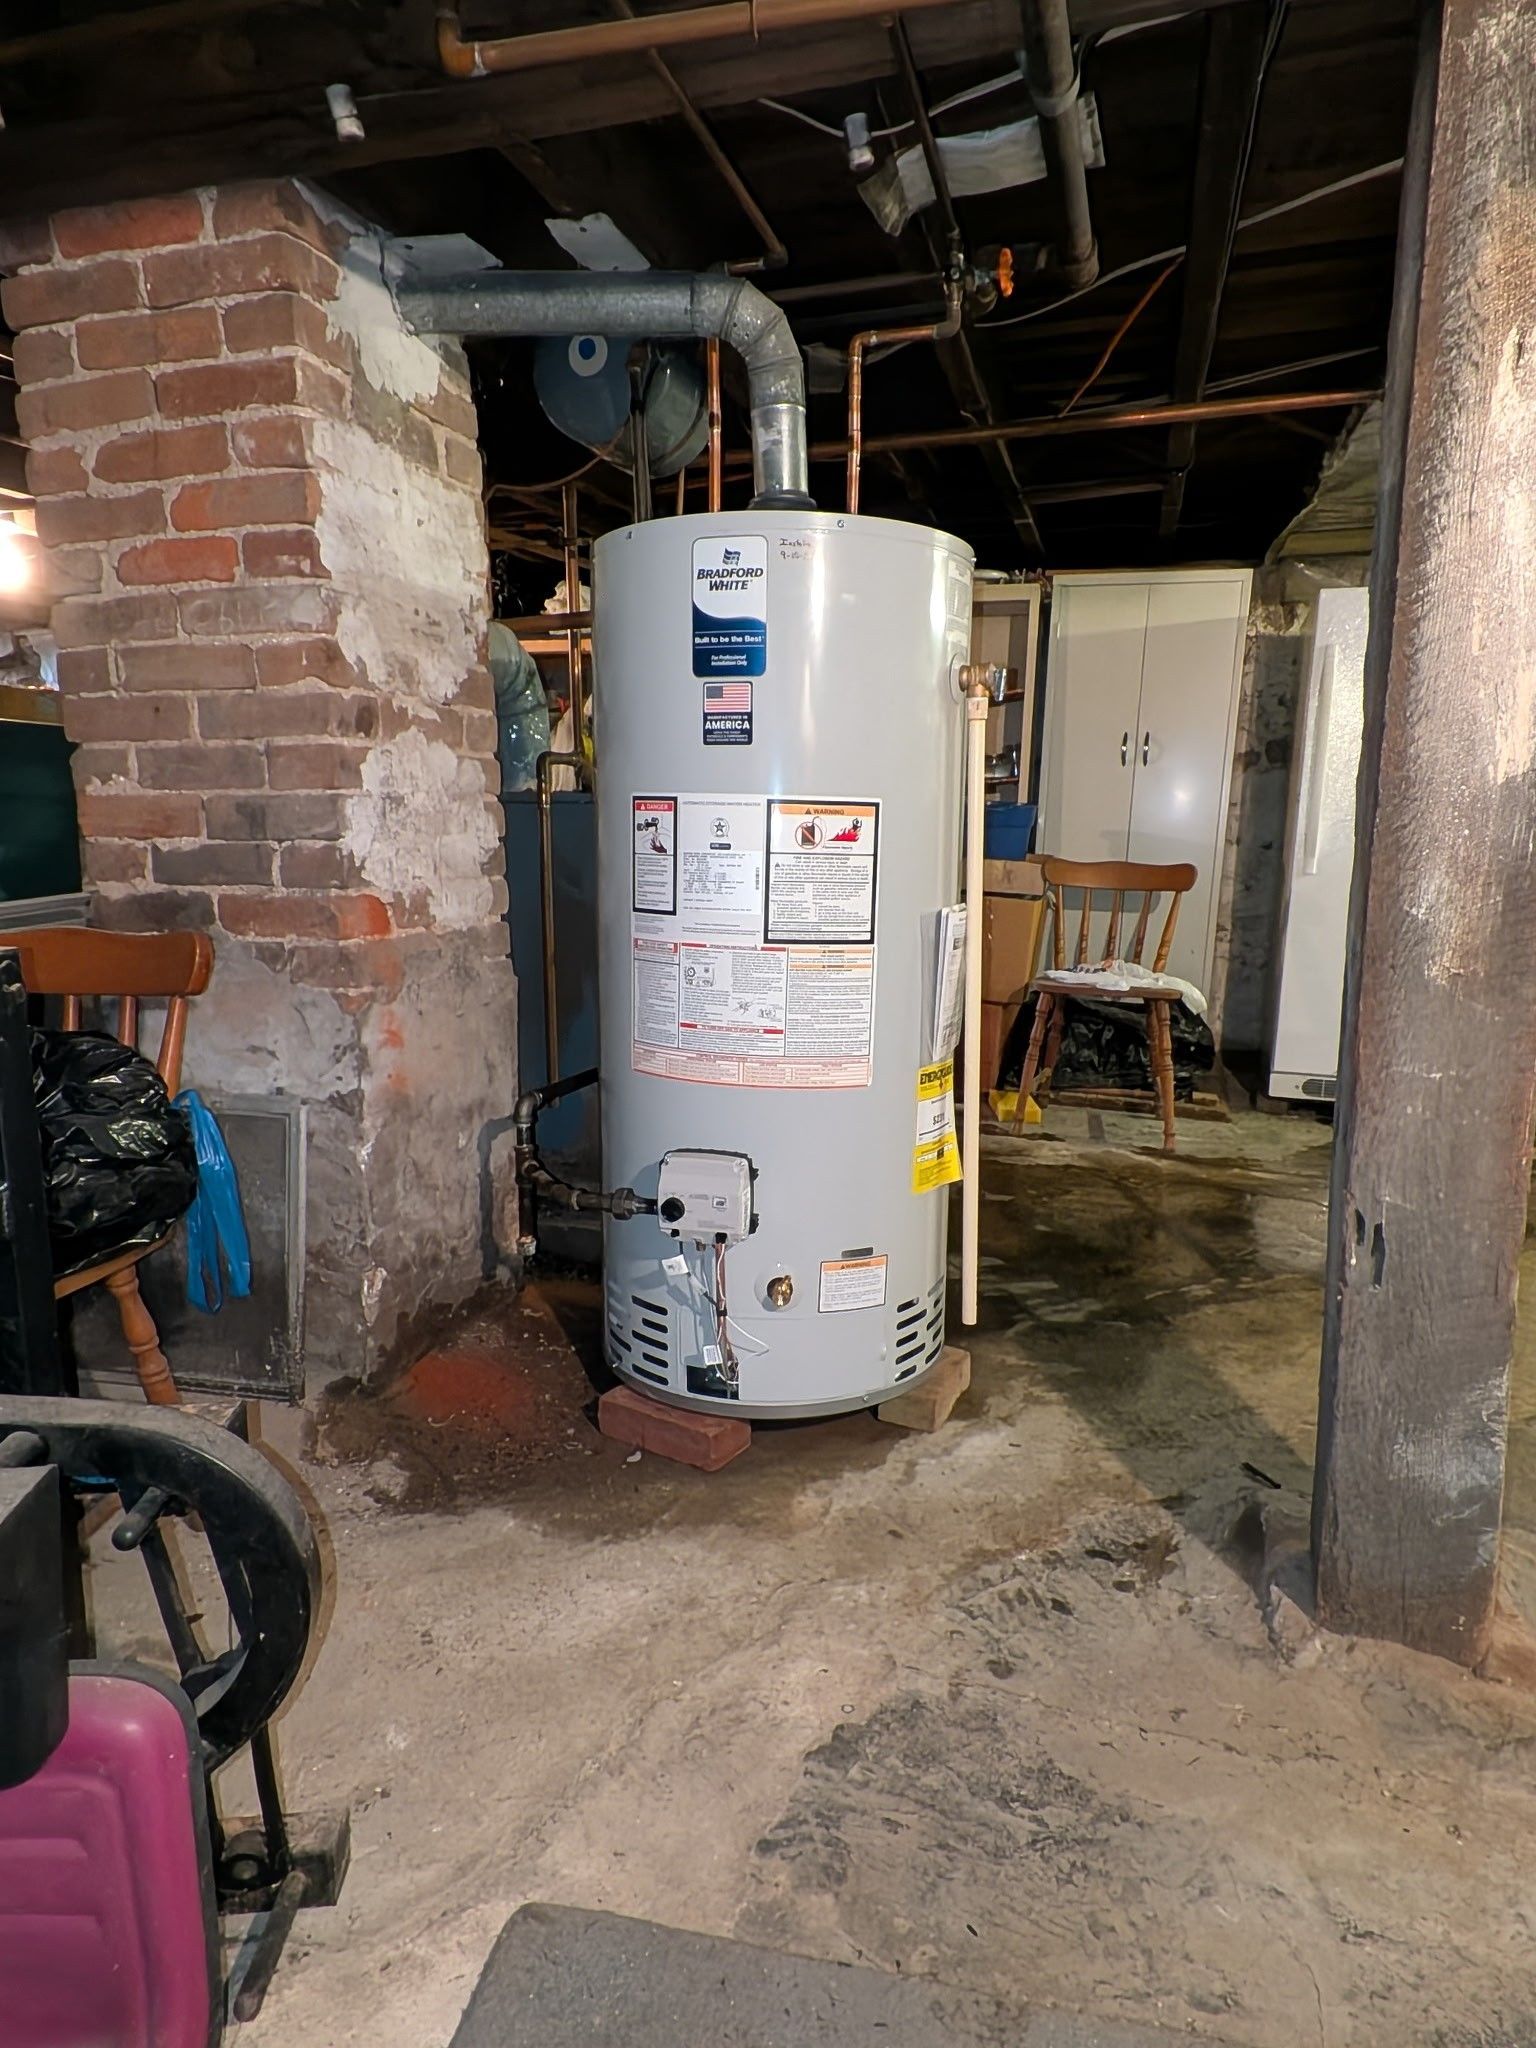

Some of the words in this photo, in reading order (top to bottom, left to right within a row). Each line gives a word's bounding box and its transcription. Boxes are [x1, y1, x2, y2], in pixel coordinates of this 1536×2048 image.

[697, 568, 764, 580] BRADFORD
[709, 580, 749, 592] WHITE
[694, 636, 710, 644] Built
[719, 635, 730, 643] be
[731, 635, 743, 643] the
[744, 635, 762, 643] Best
[705, 720, 750, 730] AMERICA
[813, 807, 845, 816] WARNING
